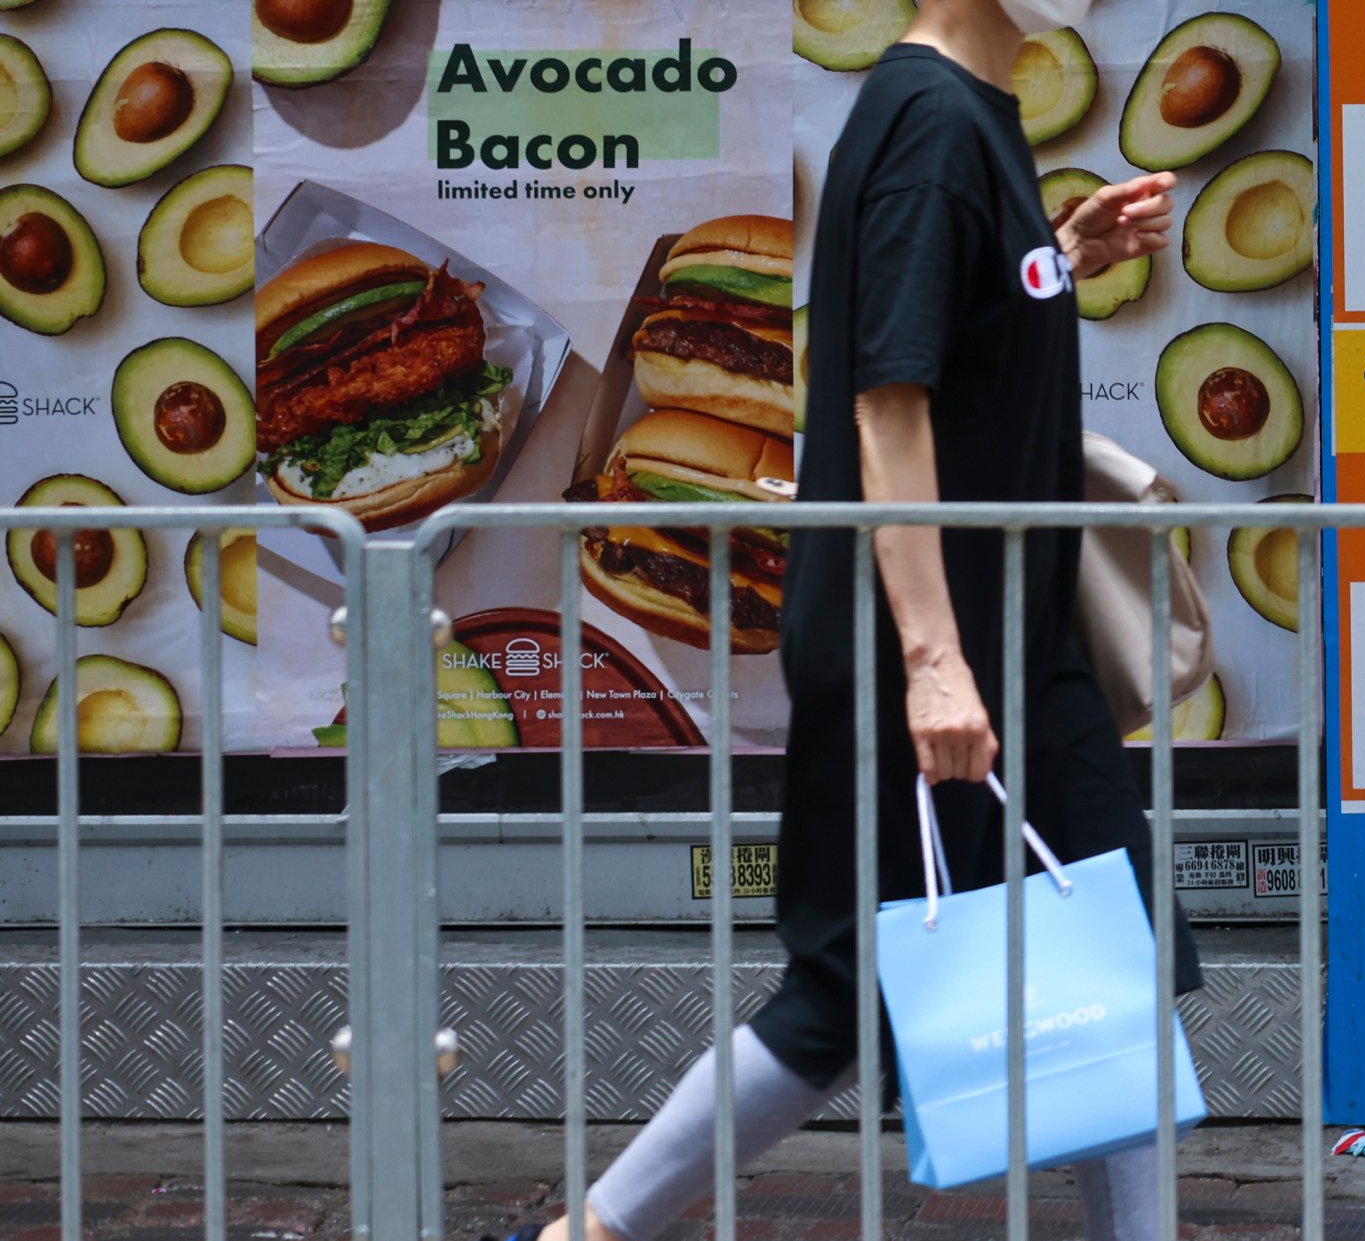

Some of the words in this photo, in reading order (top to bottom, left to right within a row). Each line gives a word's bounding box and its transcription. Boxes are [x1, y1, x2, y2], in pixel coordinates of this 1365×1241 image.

[436, 38, 738, 95] Avocado
[435, 119, 641, 171] Bacon
[437, 178, 520, 201] limited
[524, 178, 577, 200] time
[582, 179, 636, 205] only
[22, 397, 96, 416] SHACK
[442, 653, 502, 670] SHAKE
[542, 652, 606, 669] SHCK
[436, 690, 467, 701] Square
[476, 690, 513, 700] Harbour
[514, 689, 531, 701] City
[586, 690, 607, 700] New
[609, 690, 632, 699] Town
[633, 689, 657, 699] Plaza
[667, 689, 704, 701] Citygate
[737, 863, 772, 887] 8393
[1266, 868, 1296, 892] 9608
